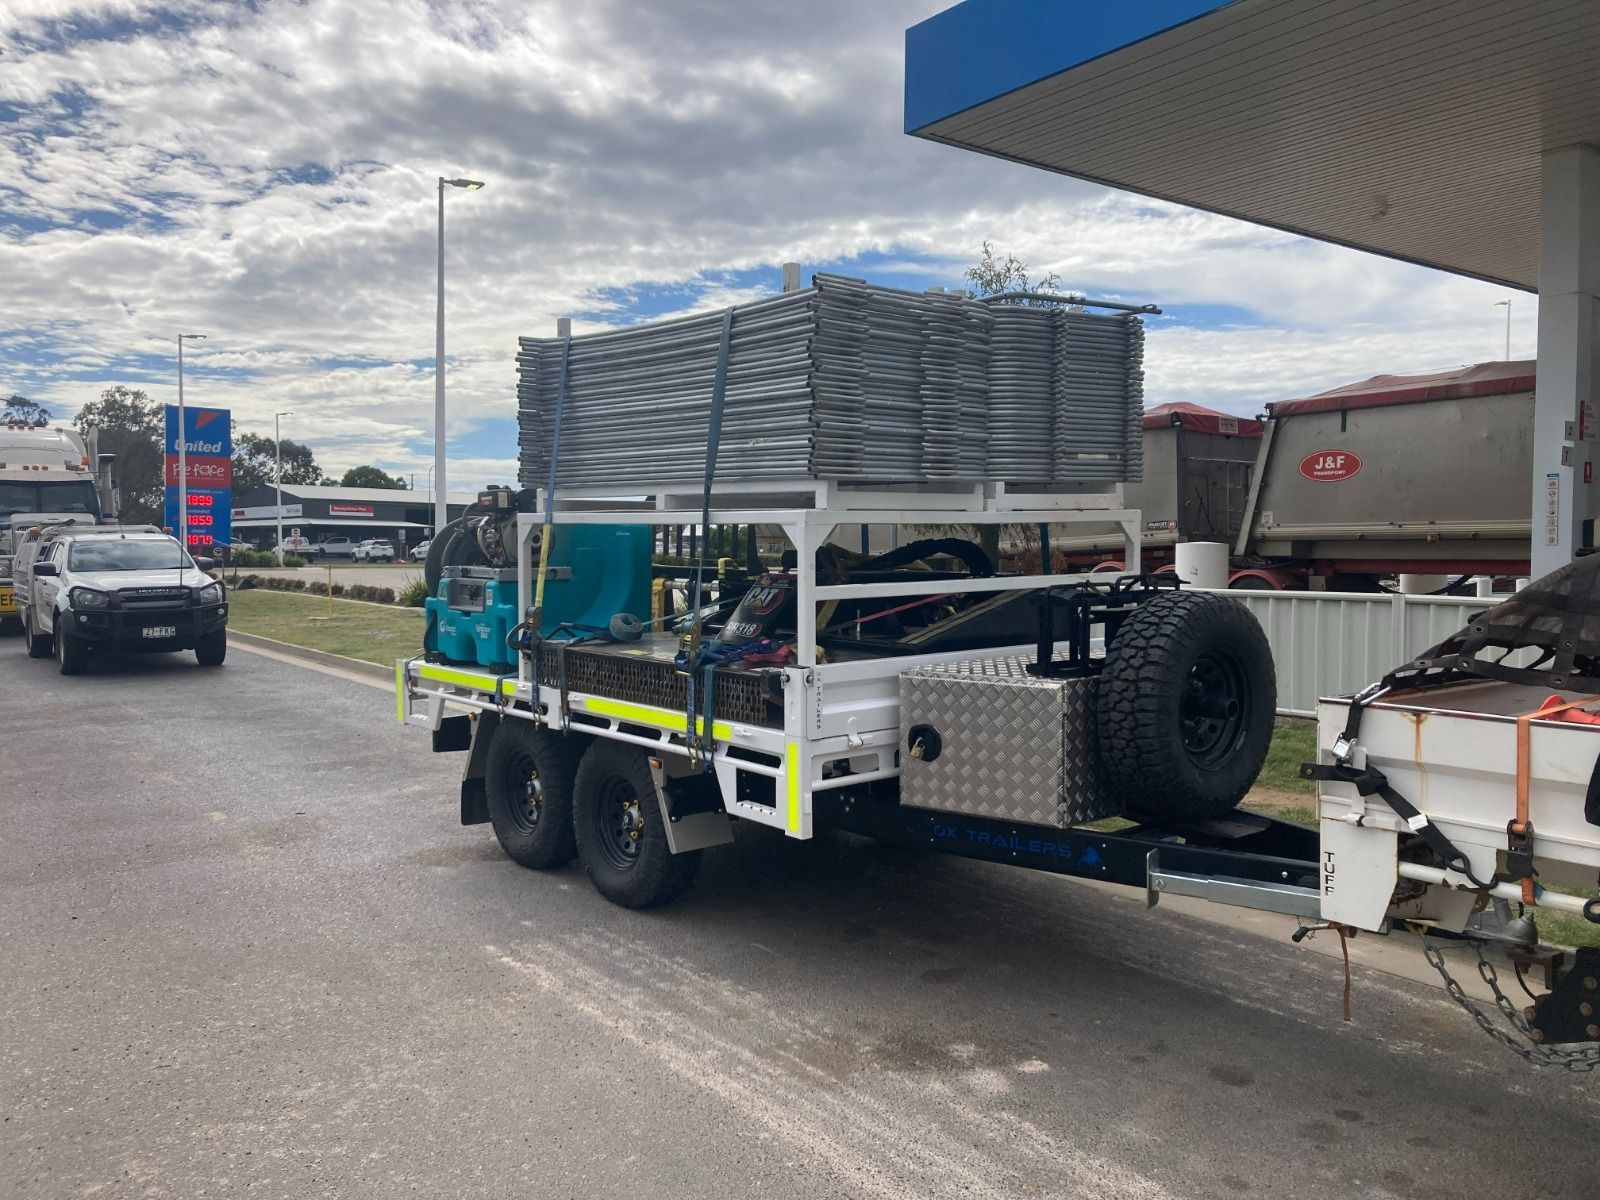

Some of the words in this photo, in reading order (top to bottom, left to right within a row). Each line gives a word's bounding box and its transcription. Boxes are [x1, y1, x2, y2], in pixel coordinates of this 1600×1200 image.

[193, 463, 225, 477] face
[1314, 455, 1346, 470] J&F
[743, 587, 780, 607] CAT
[933, 824, 957, 838] OX
[966, 830, 1072, 858] TRAILERS
[1324, 851, 1335, 896] TUFF
